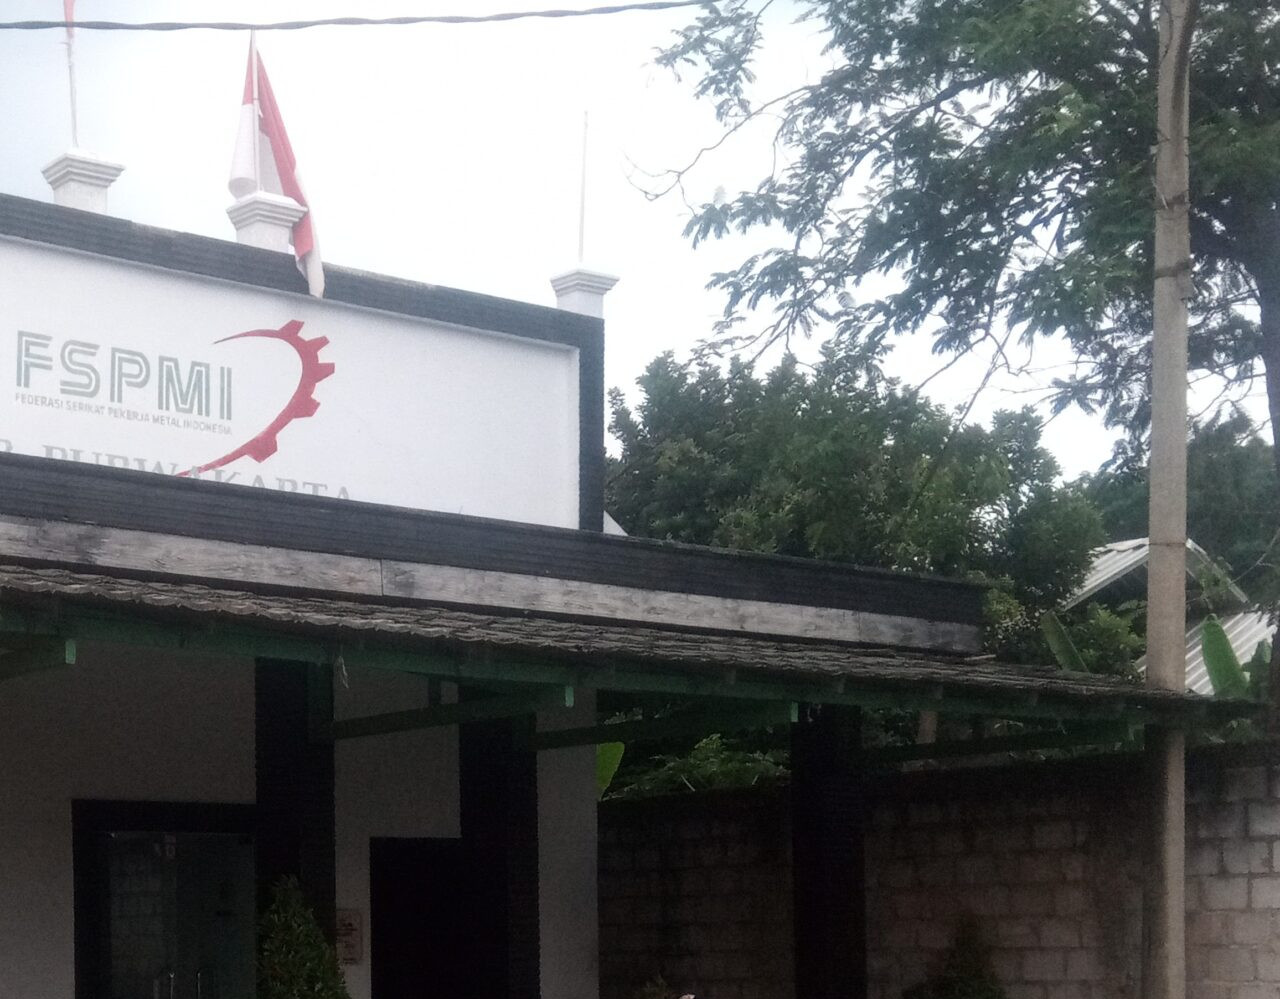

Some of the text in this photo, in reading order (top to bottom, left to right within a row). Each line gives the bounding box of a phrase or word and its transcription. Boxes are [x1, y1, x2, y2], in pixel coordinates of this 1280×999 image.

[16, 330, 233, 421] FSPMI
[15, 392, 234, 437] FEDERASI SERIKAT PEKERJA METAL INDONESIA
